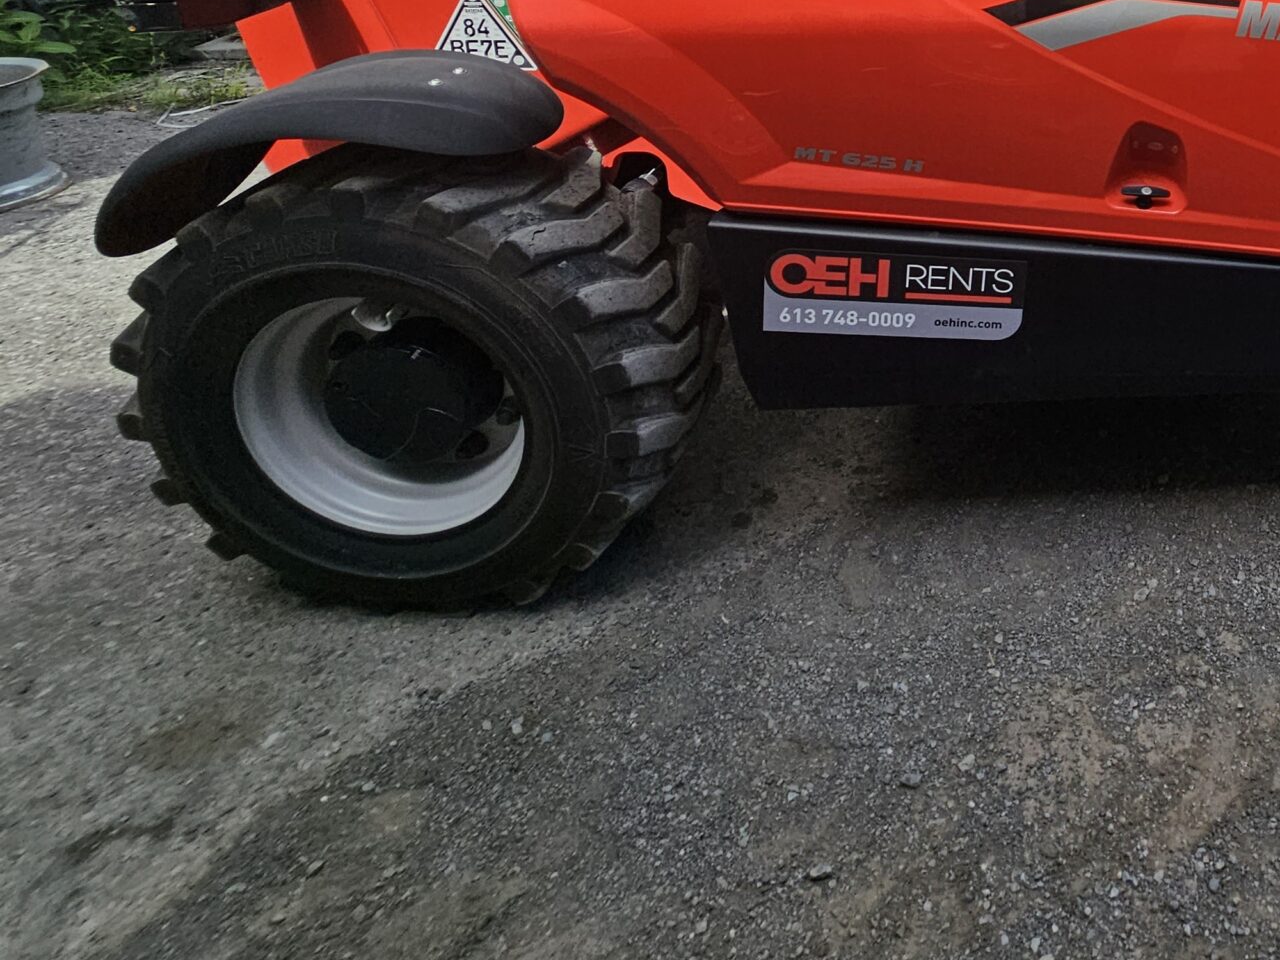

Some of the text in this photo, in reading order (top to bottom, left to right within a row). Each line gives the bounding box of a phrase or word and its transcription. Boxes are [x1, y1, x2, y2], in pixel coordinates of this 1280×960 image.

[463, 18, 490, 38] 84
[794, 146, 925, 172] MT 625 H
[770, 253, 1014, 298] OEH RENTS
[779, 307, 1002, 330] 613 748-0009 oehinc.com
